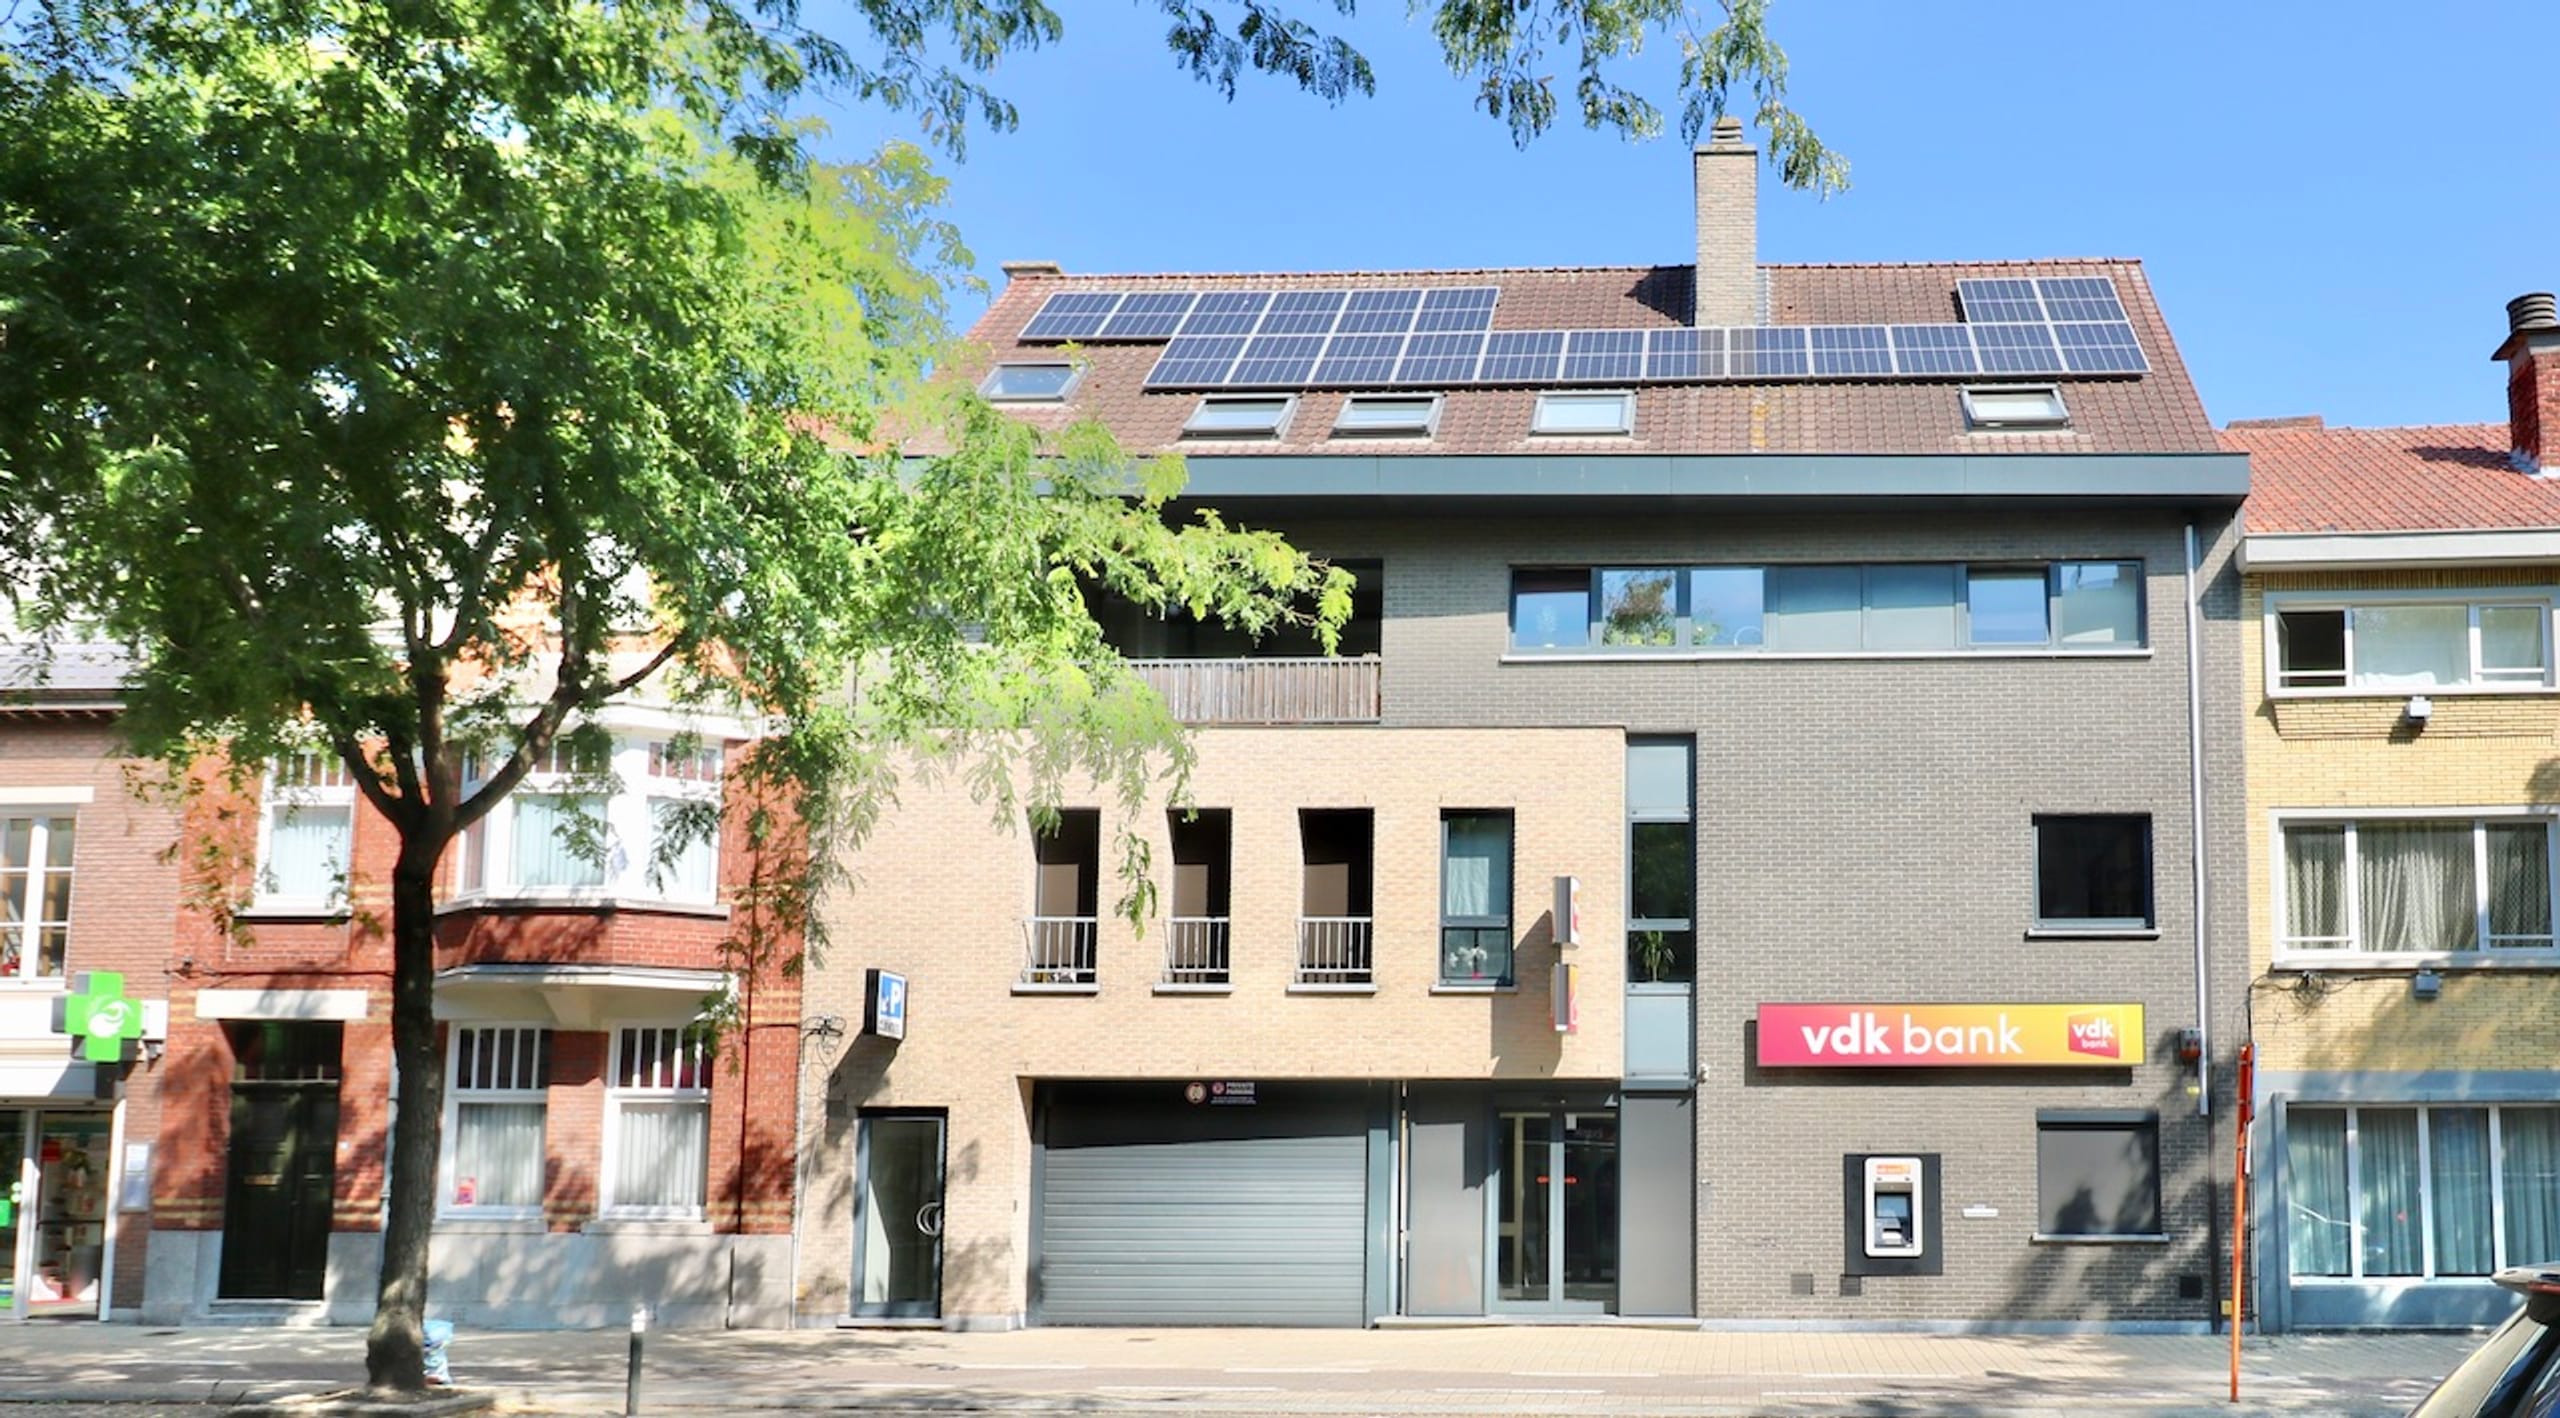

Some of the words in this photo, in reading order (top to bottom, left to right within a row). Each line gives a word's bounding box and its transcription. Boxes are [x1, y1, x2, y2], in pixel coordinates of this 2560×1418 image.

[890, 981, 901, 1014] P
[1801, 1012, 1891, 1055] vdk
[1903, 1013, 2023, 1055] bank
[2072, 1017, 2114, 1038] vdk
[2081, 1038, 2109, 1049] bank
